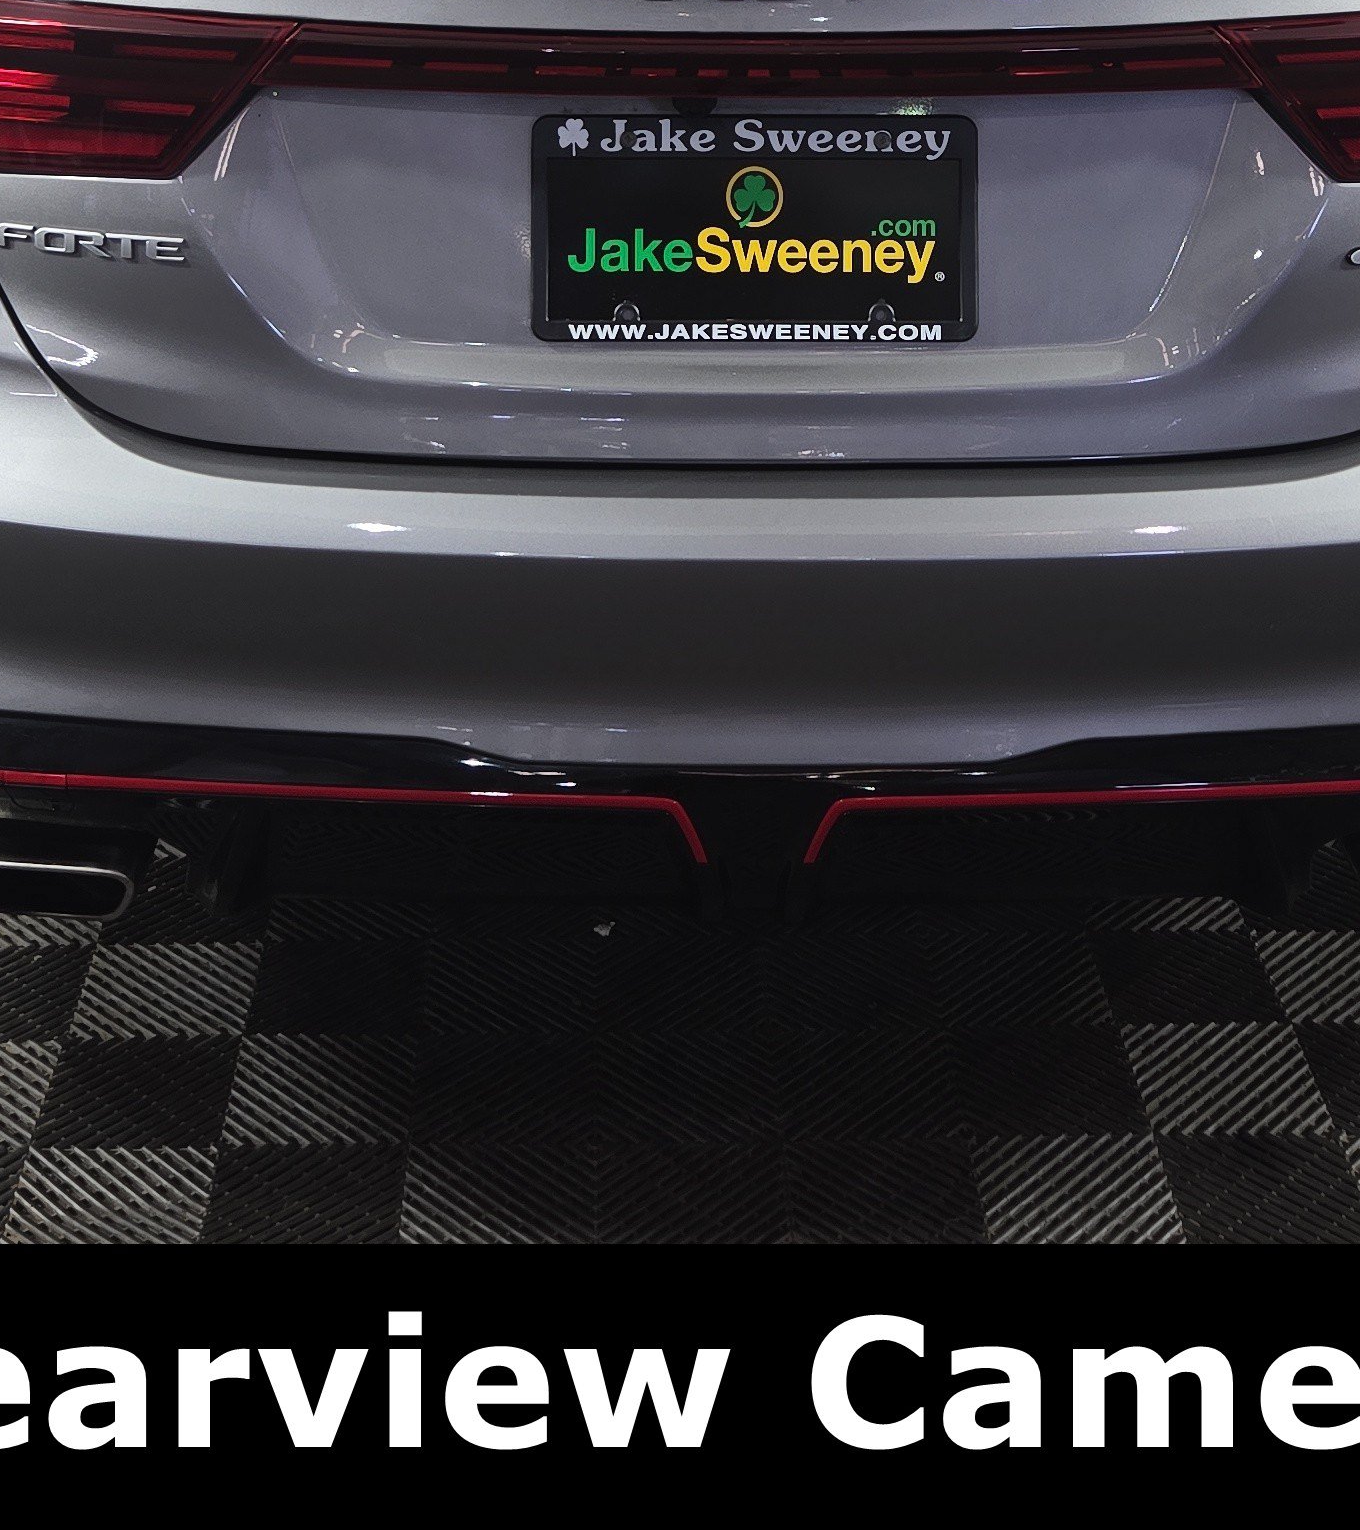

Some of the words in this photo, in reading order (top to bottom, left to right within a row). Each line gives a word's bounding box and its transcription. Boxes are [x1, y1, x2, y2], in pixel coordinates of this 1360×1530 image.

[600, 118, 716, 152] Jake
[733, 118, 951, 160] Sweeney
[568, 323, 943, 341] WWW.JAKESWEENEY.COM
